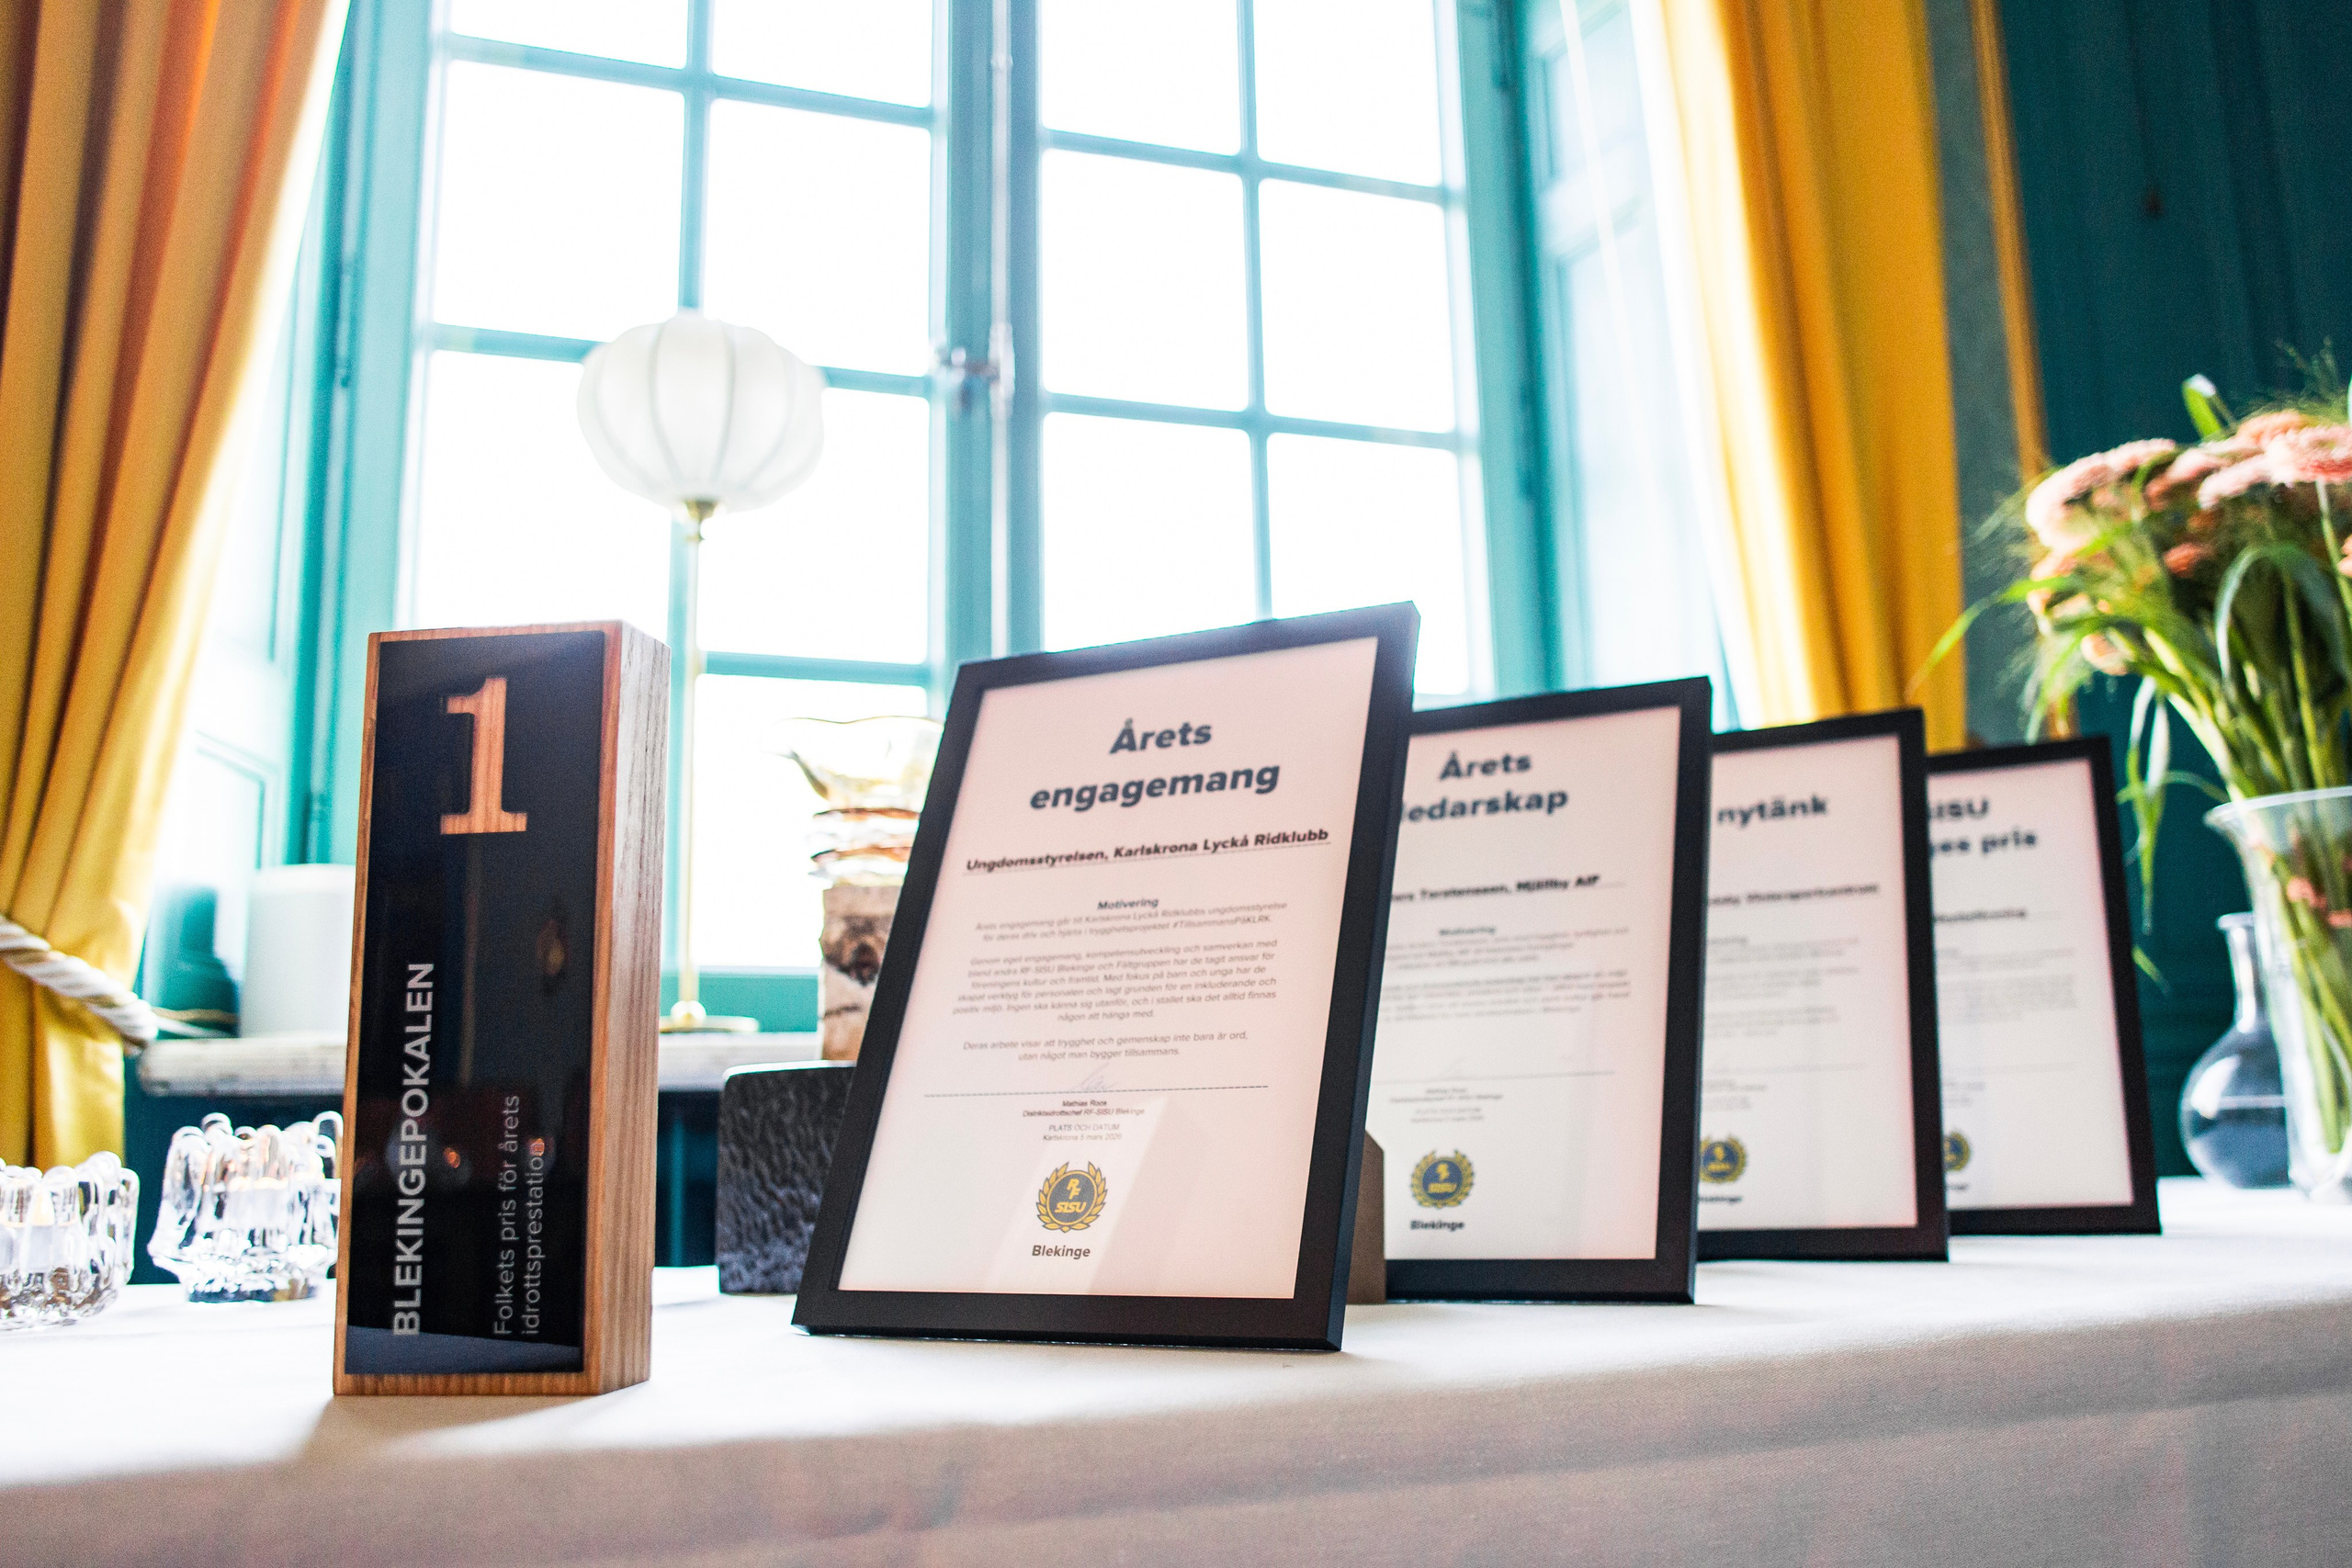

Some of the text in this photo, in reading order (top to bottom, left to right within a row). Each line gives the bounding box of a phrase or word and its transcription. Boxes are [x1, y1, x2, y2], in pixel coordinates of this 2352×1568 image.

[1109, 717, 1213, 755] Årets
[441, 677, 528, 835] 1
[1438, 749, 1532, 781] Årets
[1029, 763, 1281, 812] engagemang
[1717, 794, 1826, 829] nytänk
[966, 828, 1329, 873] Ungdomsstyrelsen, Karlskrona Lyckå Ridklubb
[1981, 826, 2038, 858] pris
[1097, 898, 1159, 910] Motivering
[1134, 909, 1158, 921] Lyckå
[1208, 900, 1287, 915] ungdomsstyrelse
[1040, 928, 1056, 938] och
[1183, 942, 1200, 952] och
[1204, 940, 1253, 951] samverkan
[1256, 938, 1277, 947] med
[1057, 962, 1095, 973] Blekinge
[1097, 960, 1114, 969] och
[1173, 956, 1188, 965] har
[1191, 955, 1203, 964] de
[1205, 953, 1226, 964] tagit
[1228, 953, 1259, 962] ansvar
[1261, 951, 1275, 960] för
[1049, 976, 1065, 985] och
[1103, 972, 1123, 981] Med
[1126, 971, 1149, 980] fokus
[1152, 970, 1163, 981] på
[1167, 969, 1187, 977] barn
[1190, 967, 1206, 976] och
[1210, 968, 1233, 976] unga
[1236, 965, 1250, 974] har
[1254, 964, 1266, 973] de
[1086, 986, 1102, 995] och
[1125, 983, 1162, 995] grunden
[1165, 982, 1177, 990] för
[1195, 977, 1256, 988] inkluderande
[1259, 976, 1276, 985] och
[1080, 998, 1091, 1010] sig
[1132, 996, 1148, 1005] och
[1186, 993, 1202, 1002] ska
[1204, 992, 1220, 1001] det
[1223, 990, 1246, 1000] alltid
[1248, 989, 1276, 998] finnas
[1057, 1012, 1085, 1022] någon
[1088, 1010, 1100, 1020] att
[1102, 1010, 1129, 1021] hänga
[1044, 1037, 1055, 1046] att
[1057, 1036, 1095, 1048] trygghet
[1097, 1035, 1114, 1044] och
[1117, 1033, 1170, 1045] gemenskap
[1173, 1032, 1190, 1042] inte
[1193, 1032, 1214, 1041] bara
[1216, 1031, 1227, 1039] är
[1229, 1030, 1248, 1041] ord,
[1019, 1052, 1037, 1060] utan
[1040, 1050, 1065, 1061] något
[1090, 1049, 1122, 1059] bygger
[1125, 1047, 1181, 1056] tillsammans.
[1115, 1108, 1145, 1116] Blekinge
[1092, 1123, 1120, 1132] DATUM
[391, 963, 435, 1337] BLEKINGEPOKALEN
[493, 1095, 521, 1335] Folkets pris för årets
[1054, 1201, 1087, 1213] SISU
[520, 1145, 548, 1336] idrottsprestation
[1032, 1245, 1091, 1259] Blekinge
